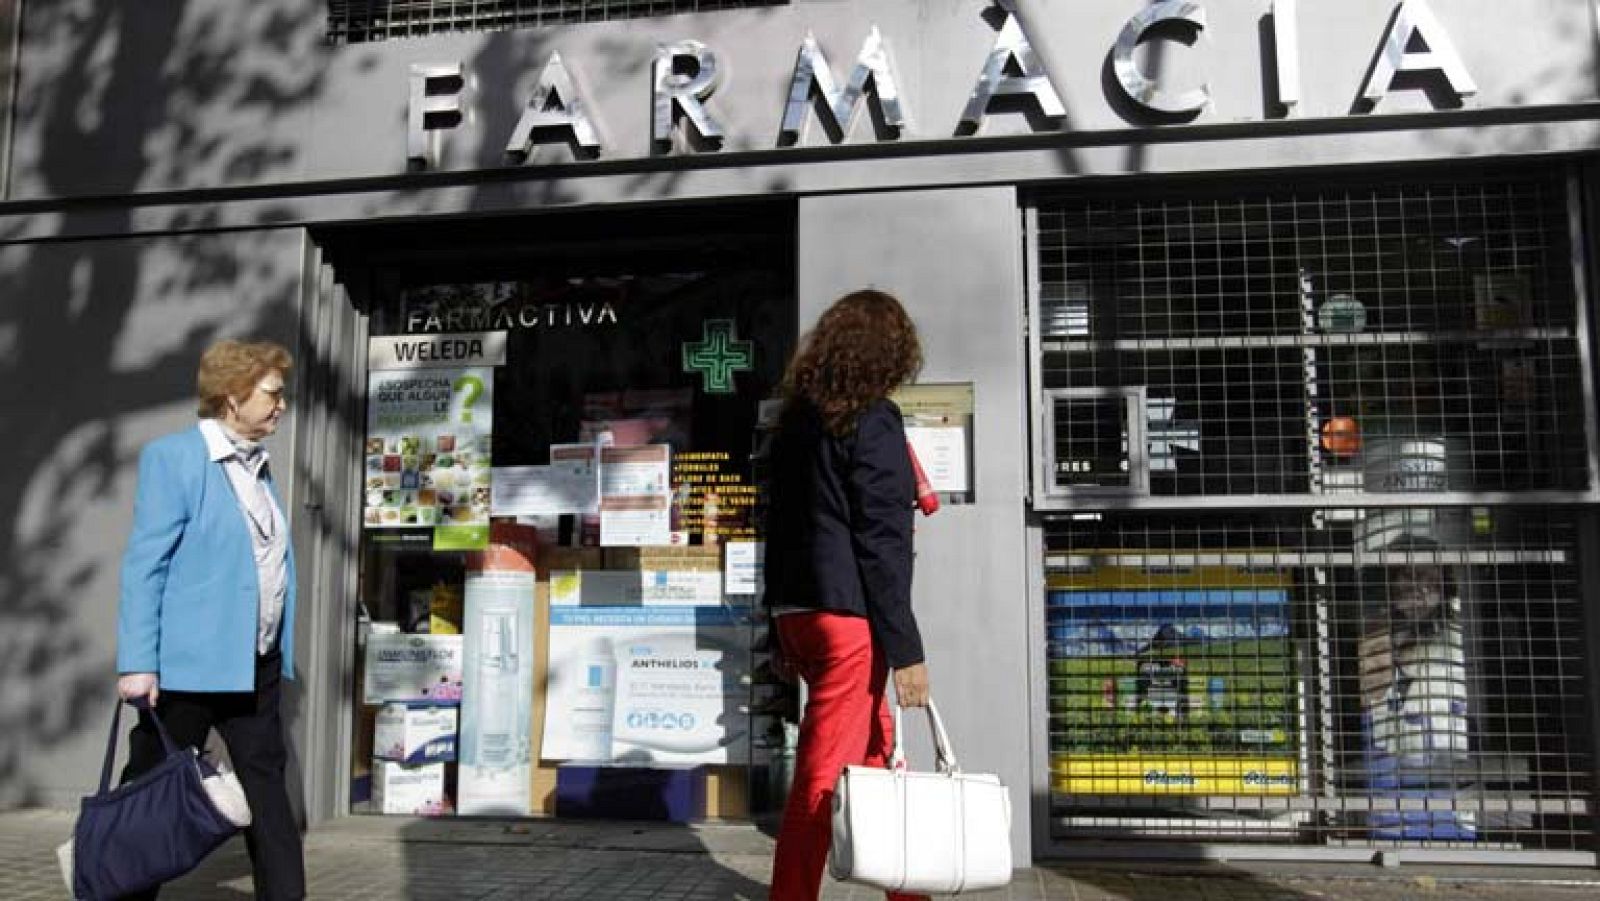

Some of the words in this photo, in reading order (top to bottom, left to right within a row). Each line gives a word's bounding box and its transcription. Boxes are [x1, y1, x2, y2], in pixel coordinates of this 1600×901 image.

[407, 302, 617, 332] FARMACTIVA
[395, 339, 484, 362] WELEDA
[631, 658, 699, 669] ANTHELIOS
